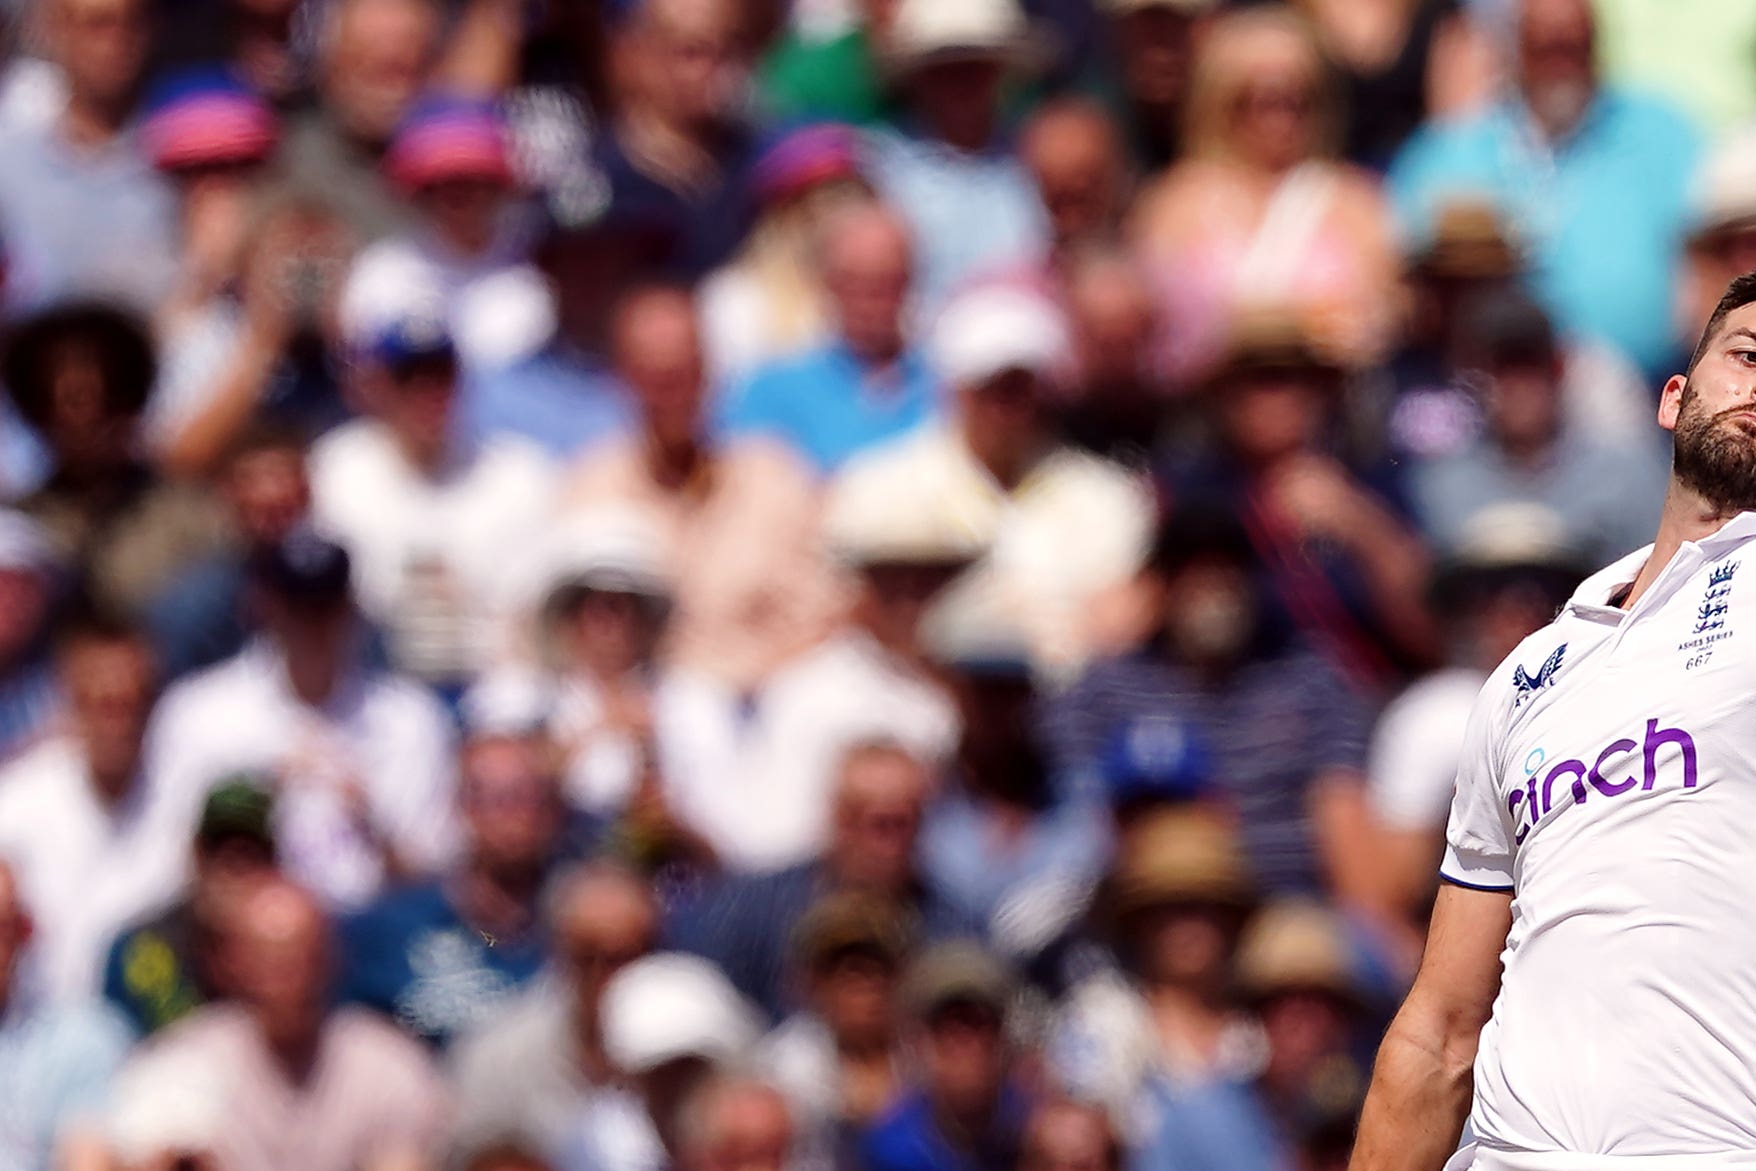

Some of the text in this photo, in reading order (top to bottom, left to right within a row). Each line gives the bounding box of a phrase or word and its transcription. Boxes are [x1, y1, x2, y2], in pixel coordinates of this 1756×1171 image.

[1677, 638, 1703, 651] ASHES
[1706, 630, 1733, 644] SERIES
[1685, 651, 1713, 670] 667
[1508, 717, 1698, 847] cinch
